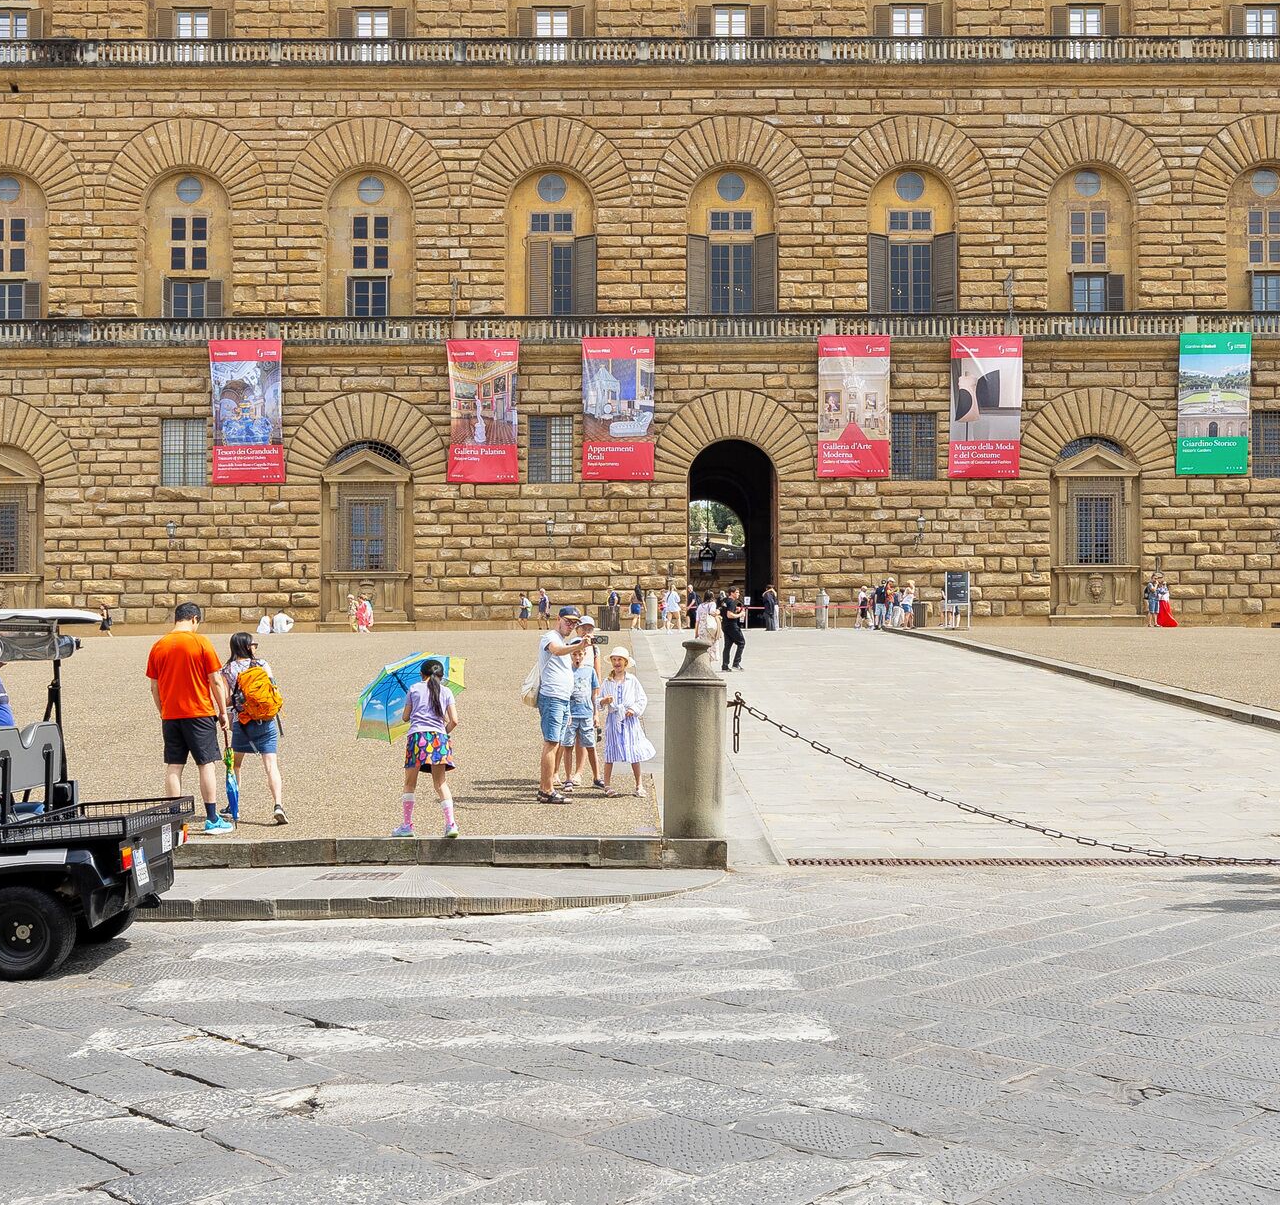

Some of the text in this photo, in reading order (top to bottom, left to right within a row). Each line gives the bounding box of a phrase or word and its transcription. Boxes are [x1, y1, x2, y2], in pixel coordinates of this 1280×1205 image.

[587, 445, 634, 454] Appartamenti
[850, 442, 872, 450] d'Arte
[216, 448, 237, 456] Tesoro
[246, 447, 279, 455] Granduchi
[454, 447, 479, 455] Galleria
[970, 451, 1001, 459] Costume
